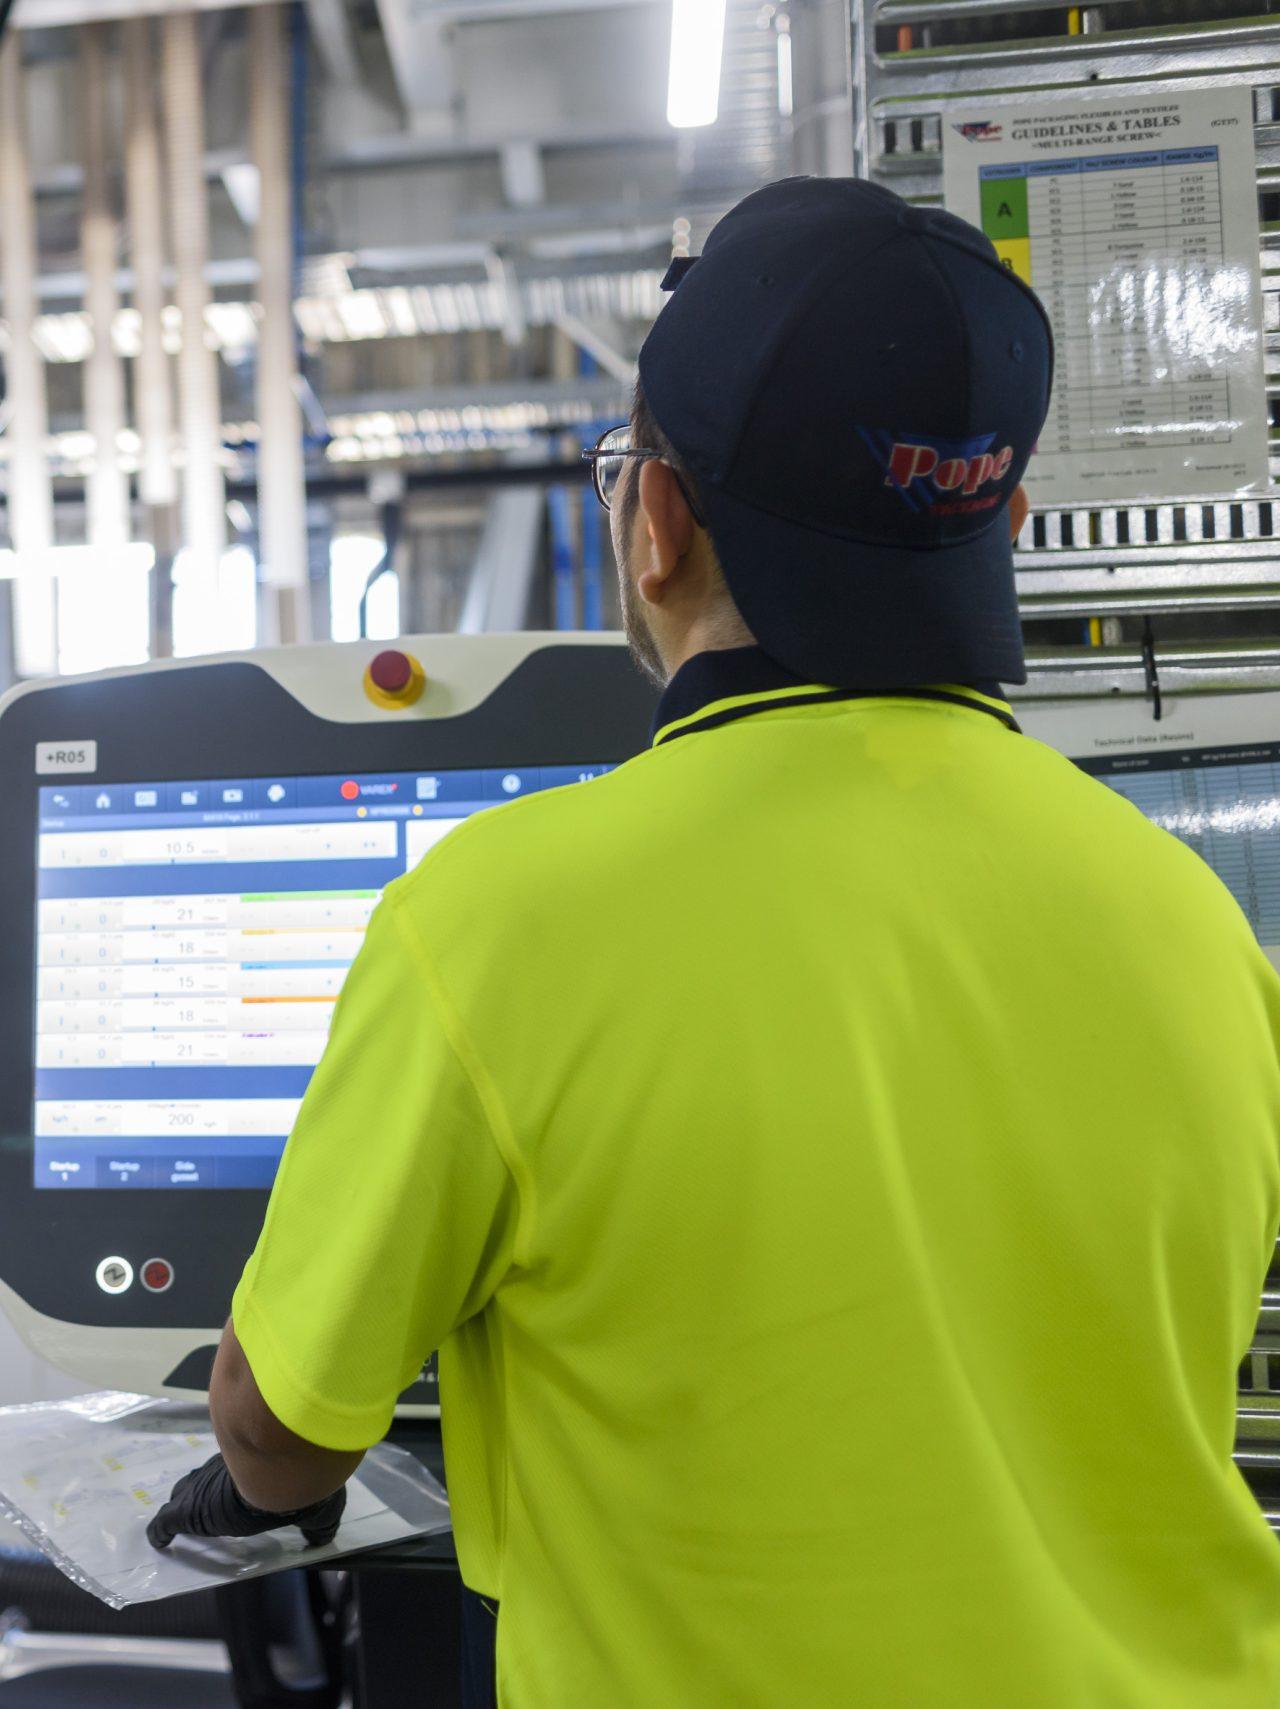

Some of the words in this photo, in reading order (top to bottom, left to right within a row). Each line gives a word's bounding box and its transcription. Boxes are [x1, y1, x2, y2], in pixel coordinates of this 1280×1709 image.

[1011, 122, 1103, 140] GUIDELINES
[1106, 121, 1118, 132] &
[1121, 115, 1181, 131] TABLES
[998, 202, 1012, 218] A
[884, 443, 1013, 495] Pope
[46, 750, 86, 764] +R05
[166, 842, 195, 854] 10.5
[177, 909, 193, 921] 21
[179, 942, 194, 954] 18
[179, 976, 194, 988] 15
[179, 1010, 194, 1022] 18
[177, 1044, 193, 1057] 21
[168, 1113, 194, 1126] 200
